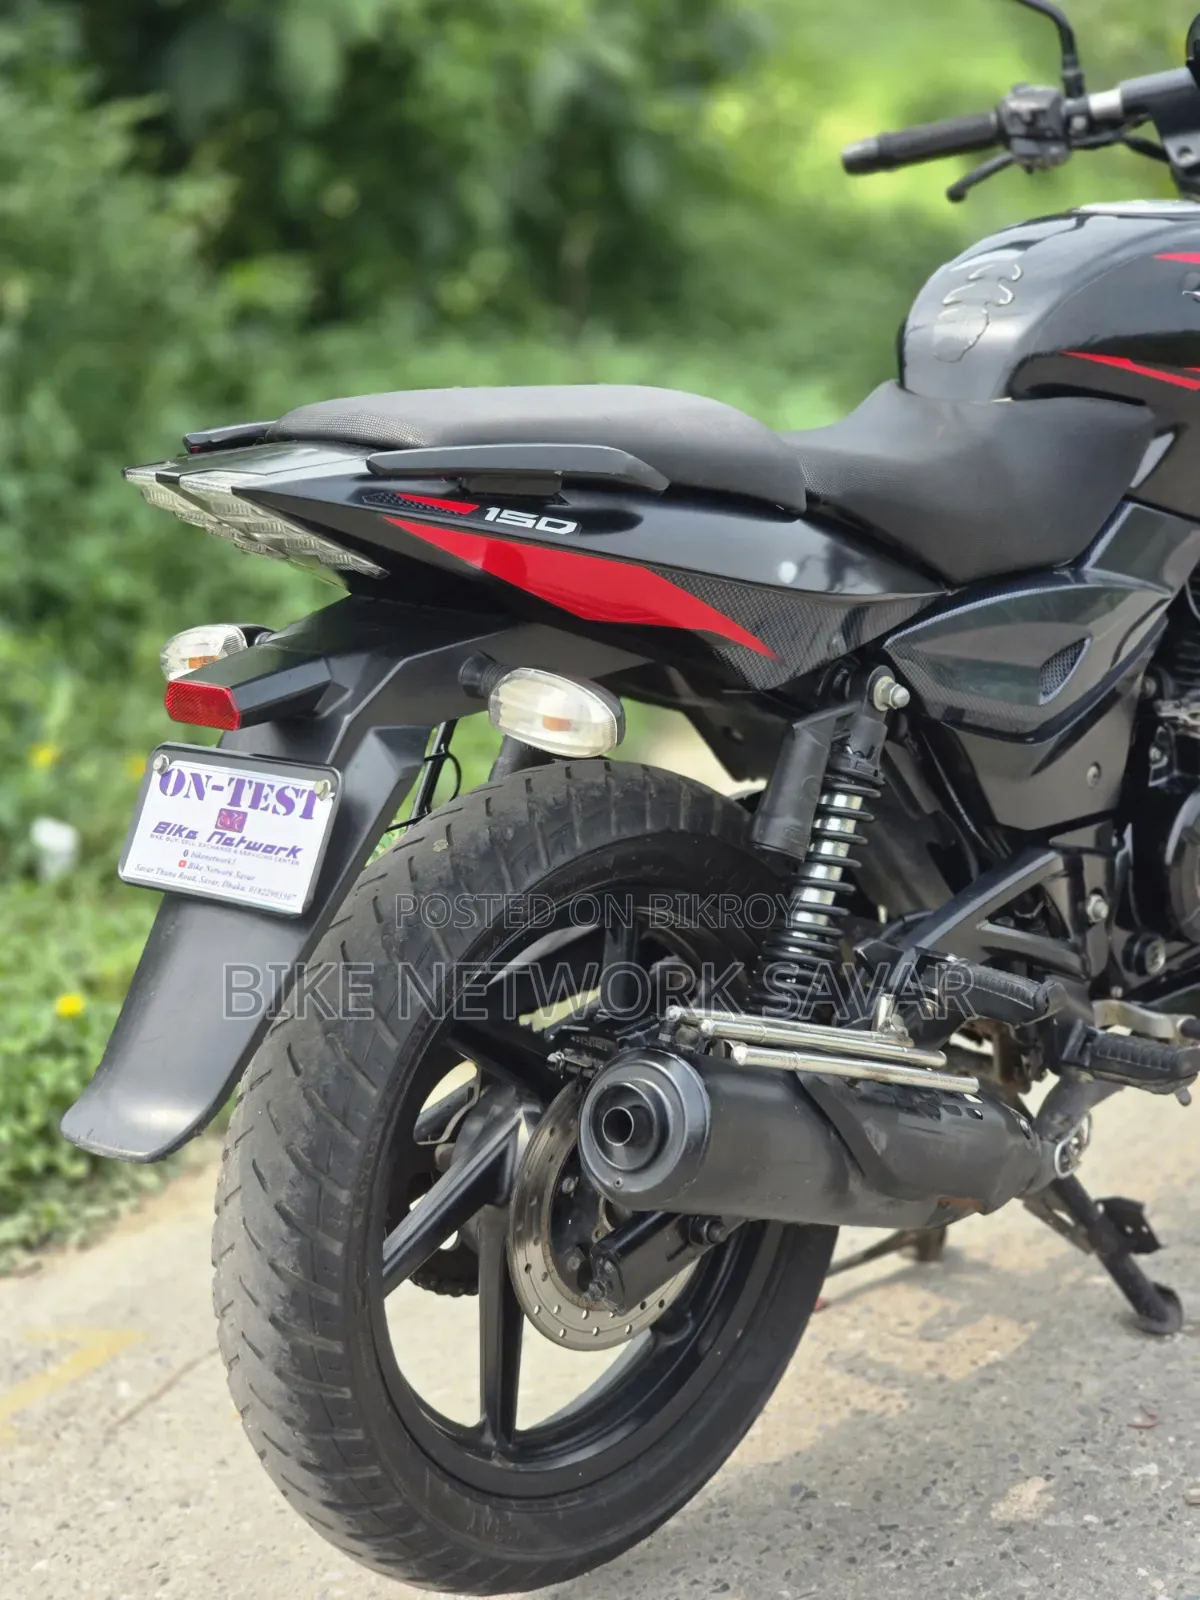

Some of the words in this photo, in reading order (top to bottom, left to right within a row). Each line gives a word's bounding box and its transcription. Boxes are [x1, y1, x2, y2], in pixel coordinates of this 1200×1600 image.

[484, 506, 578, 535] 150
[159, 768, 319, 820] ON-TEST
[187, 861, 204, 872] Bike
[274, 856, 300, 866] CENTER
